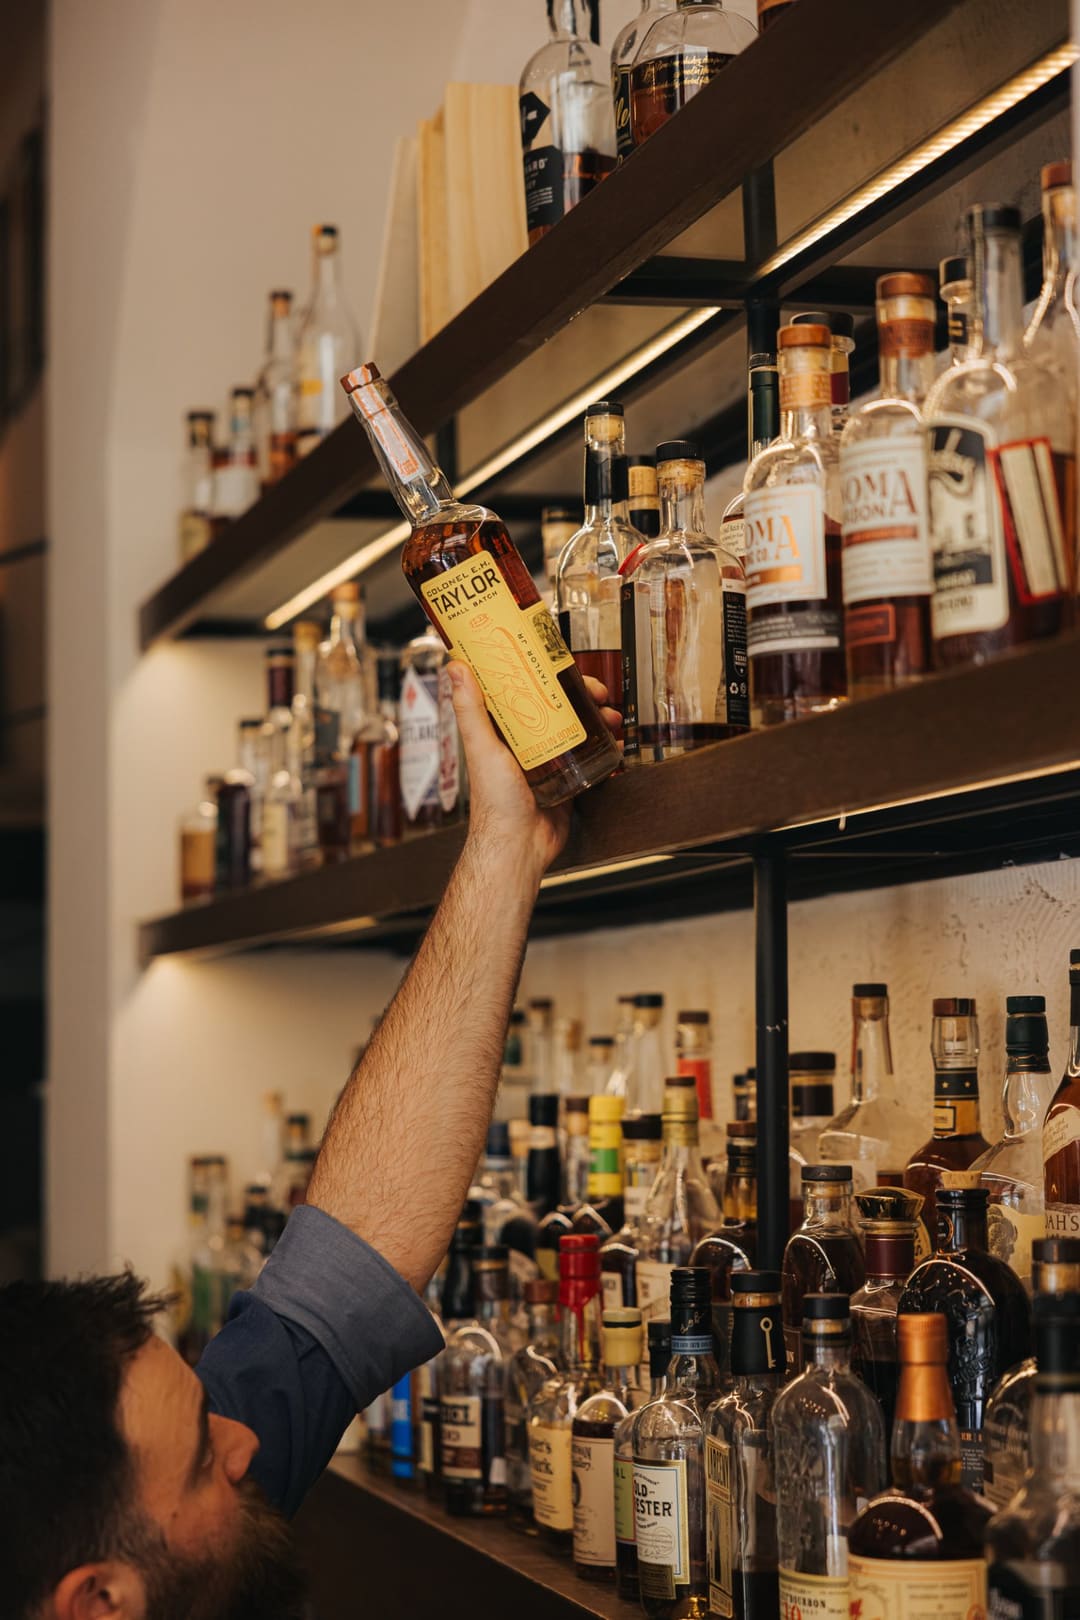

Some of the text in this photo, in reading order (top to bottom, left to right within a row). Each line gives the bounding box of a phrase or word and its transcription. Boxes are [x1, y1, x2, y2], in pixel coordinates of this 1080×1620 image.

[427, 560, 490, 598] COLONEL E.H.
[431, 568, 501, 615] TAYLOR
[447, 590, 498, 621] SMALL BATCH
[526, 650, 549, 686] TAYLOR
